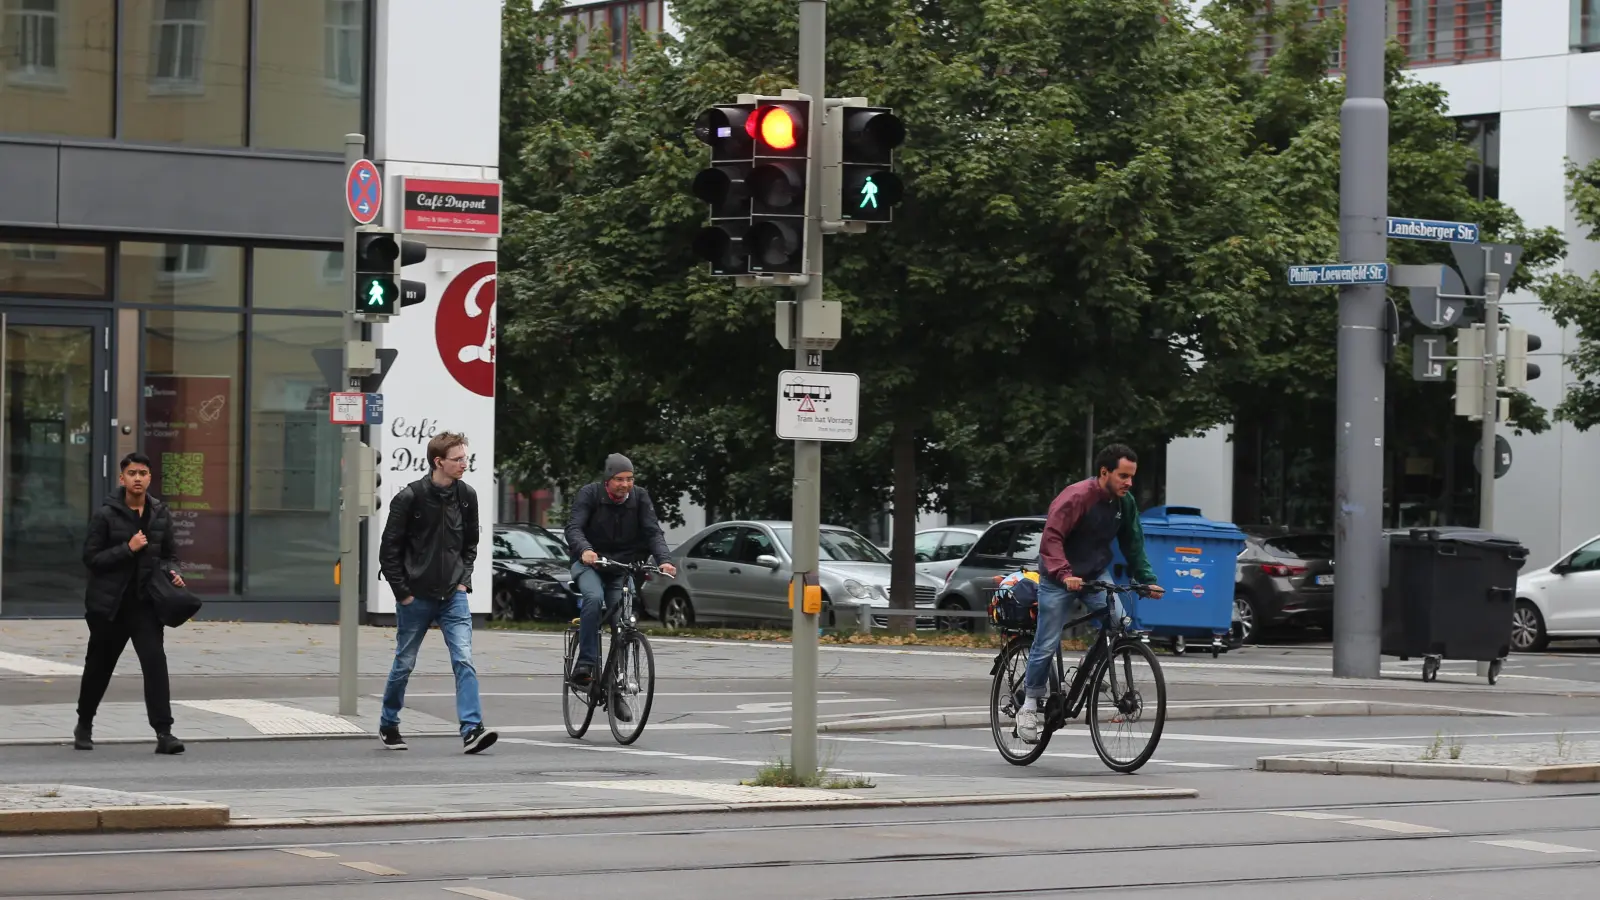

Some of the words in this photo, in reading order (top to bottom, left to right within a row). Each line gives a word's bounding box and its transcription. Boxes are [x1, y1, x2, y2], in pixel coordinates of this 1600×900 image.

[416, 193, 443, 210] Café
[444, 195, 487, 212] Dupont
[1387, 219, 1456, 241] Landsberger
[1457, 224, 1475, 240] Str.
[1290, 265, 1384, 284] Philipp-Loewenfeld-Str.
[391, 416, 438, 444] Café
[796, 414, 813, 423] Tram
[814, 415, 826, 424] hat
[827, 416, 853, 426] Vorrang
[390, 447, 478, 472] Dut
